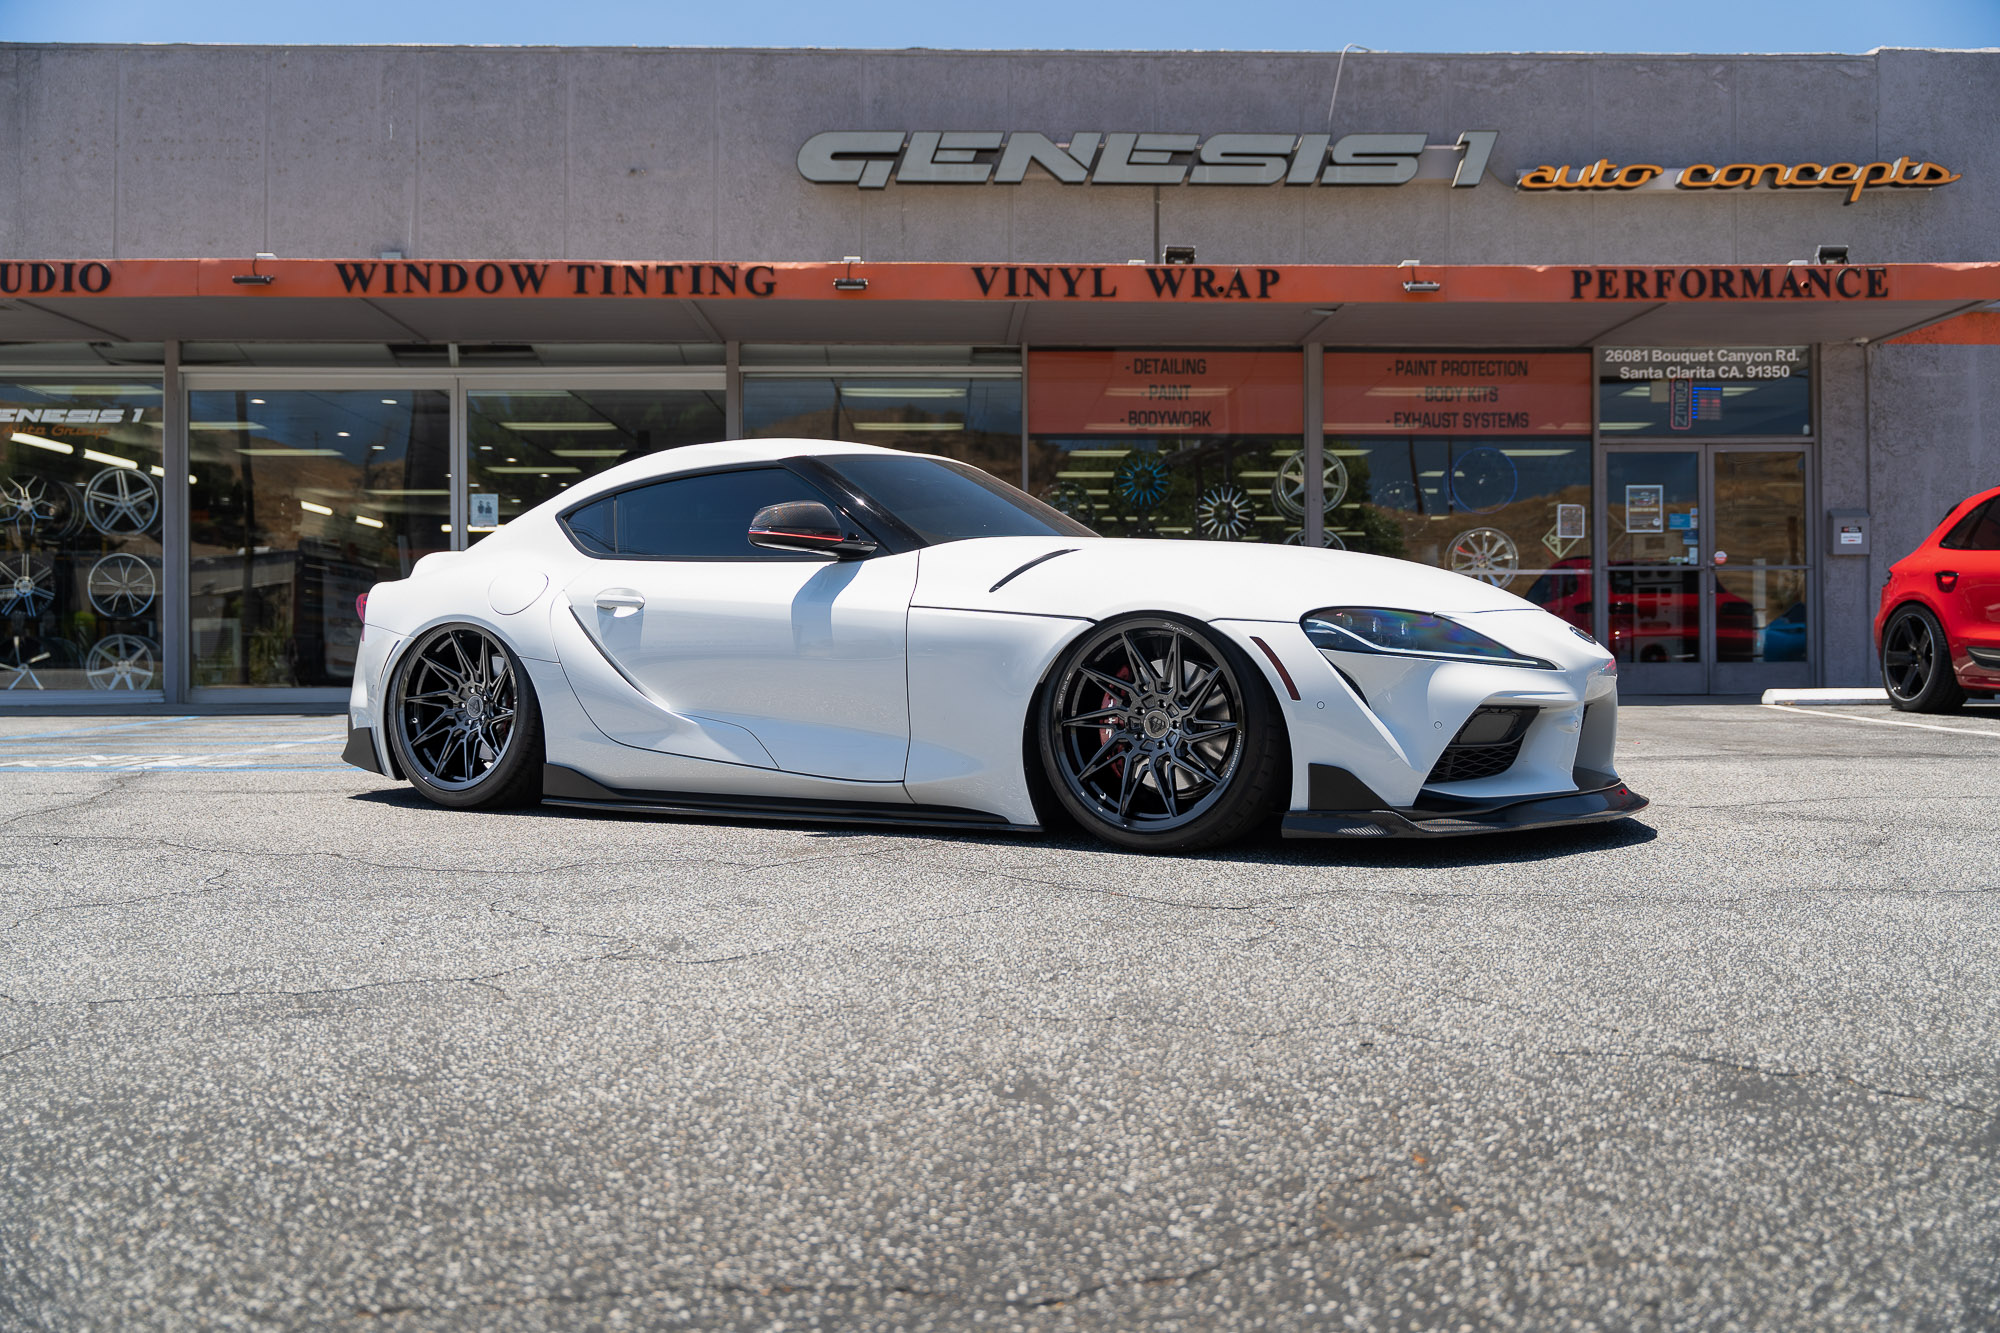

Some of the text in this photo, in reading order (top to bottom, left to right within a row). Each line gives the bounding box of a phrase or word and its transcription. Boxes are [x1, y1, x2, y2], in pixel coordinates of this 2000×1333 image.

[796, 130, 1499, 188] GENESIS 1
[1517, 155, 1962, 205] auto concepts
[0, 262, 111, 294] UDIO
[335, 262, 778, 296] WINDOW TINTING
[971, 266, 1280, 299] VINYL WRAP
[1571, 266, 1889, 299] PERFORMANCE
[1604, 349, 1800, 364] 26081 Bouquet Canyon Rd.
[1133, 358, 1207, 375] DETAILING
[1395, 360, 1528, 377] PAINT PROTECTION
[1619, 365, 1790, 379] Santa Clarita CA. 91350
[1148, 384, 1191, 401] PAINT
[1424, 386, 1499, 402] BODY KITS
[132, 408, 144, 423] 1
[1128, 410, 1212, 427] BODYWORK
[1394, 411, 1529, 429] EXHAUST SYSTEMS
